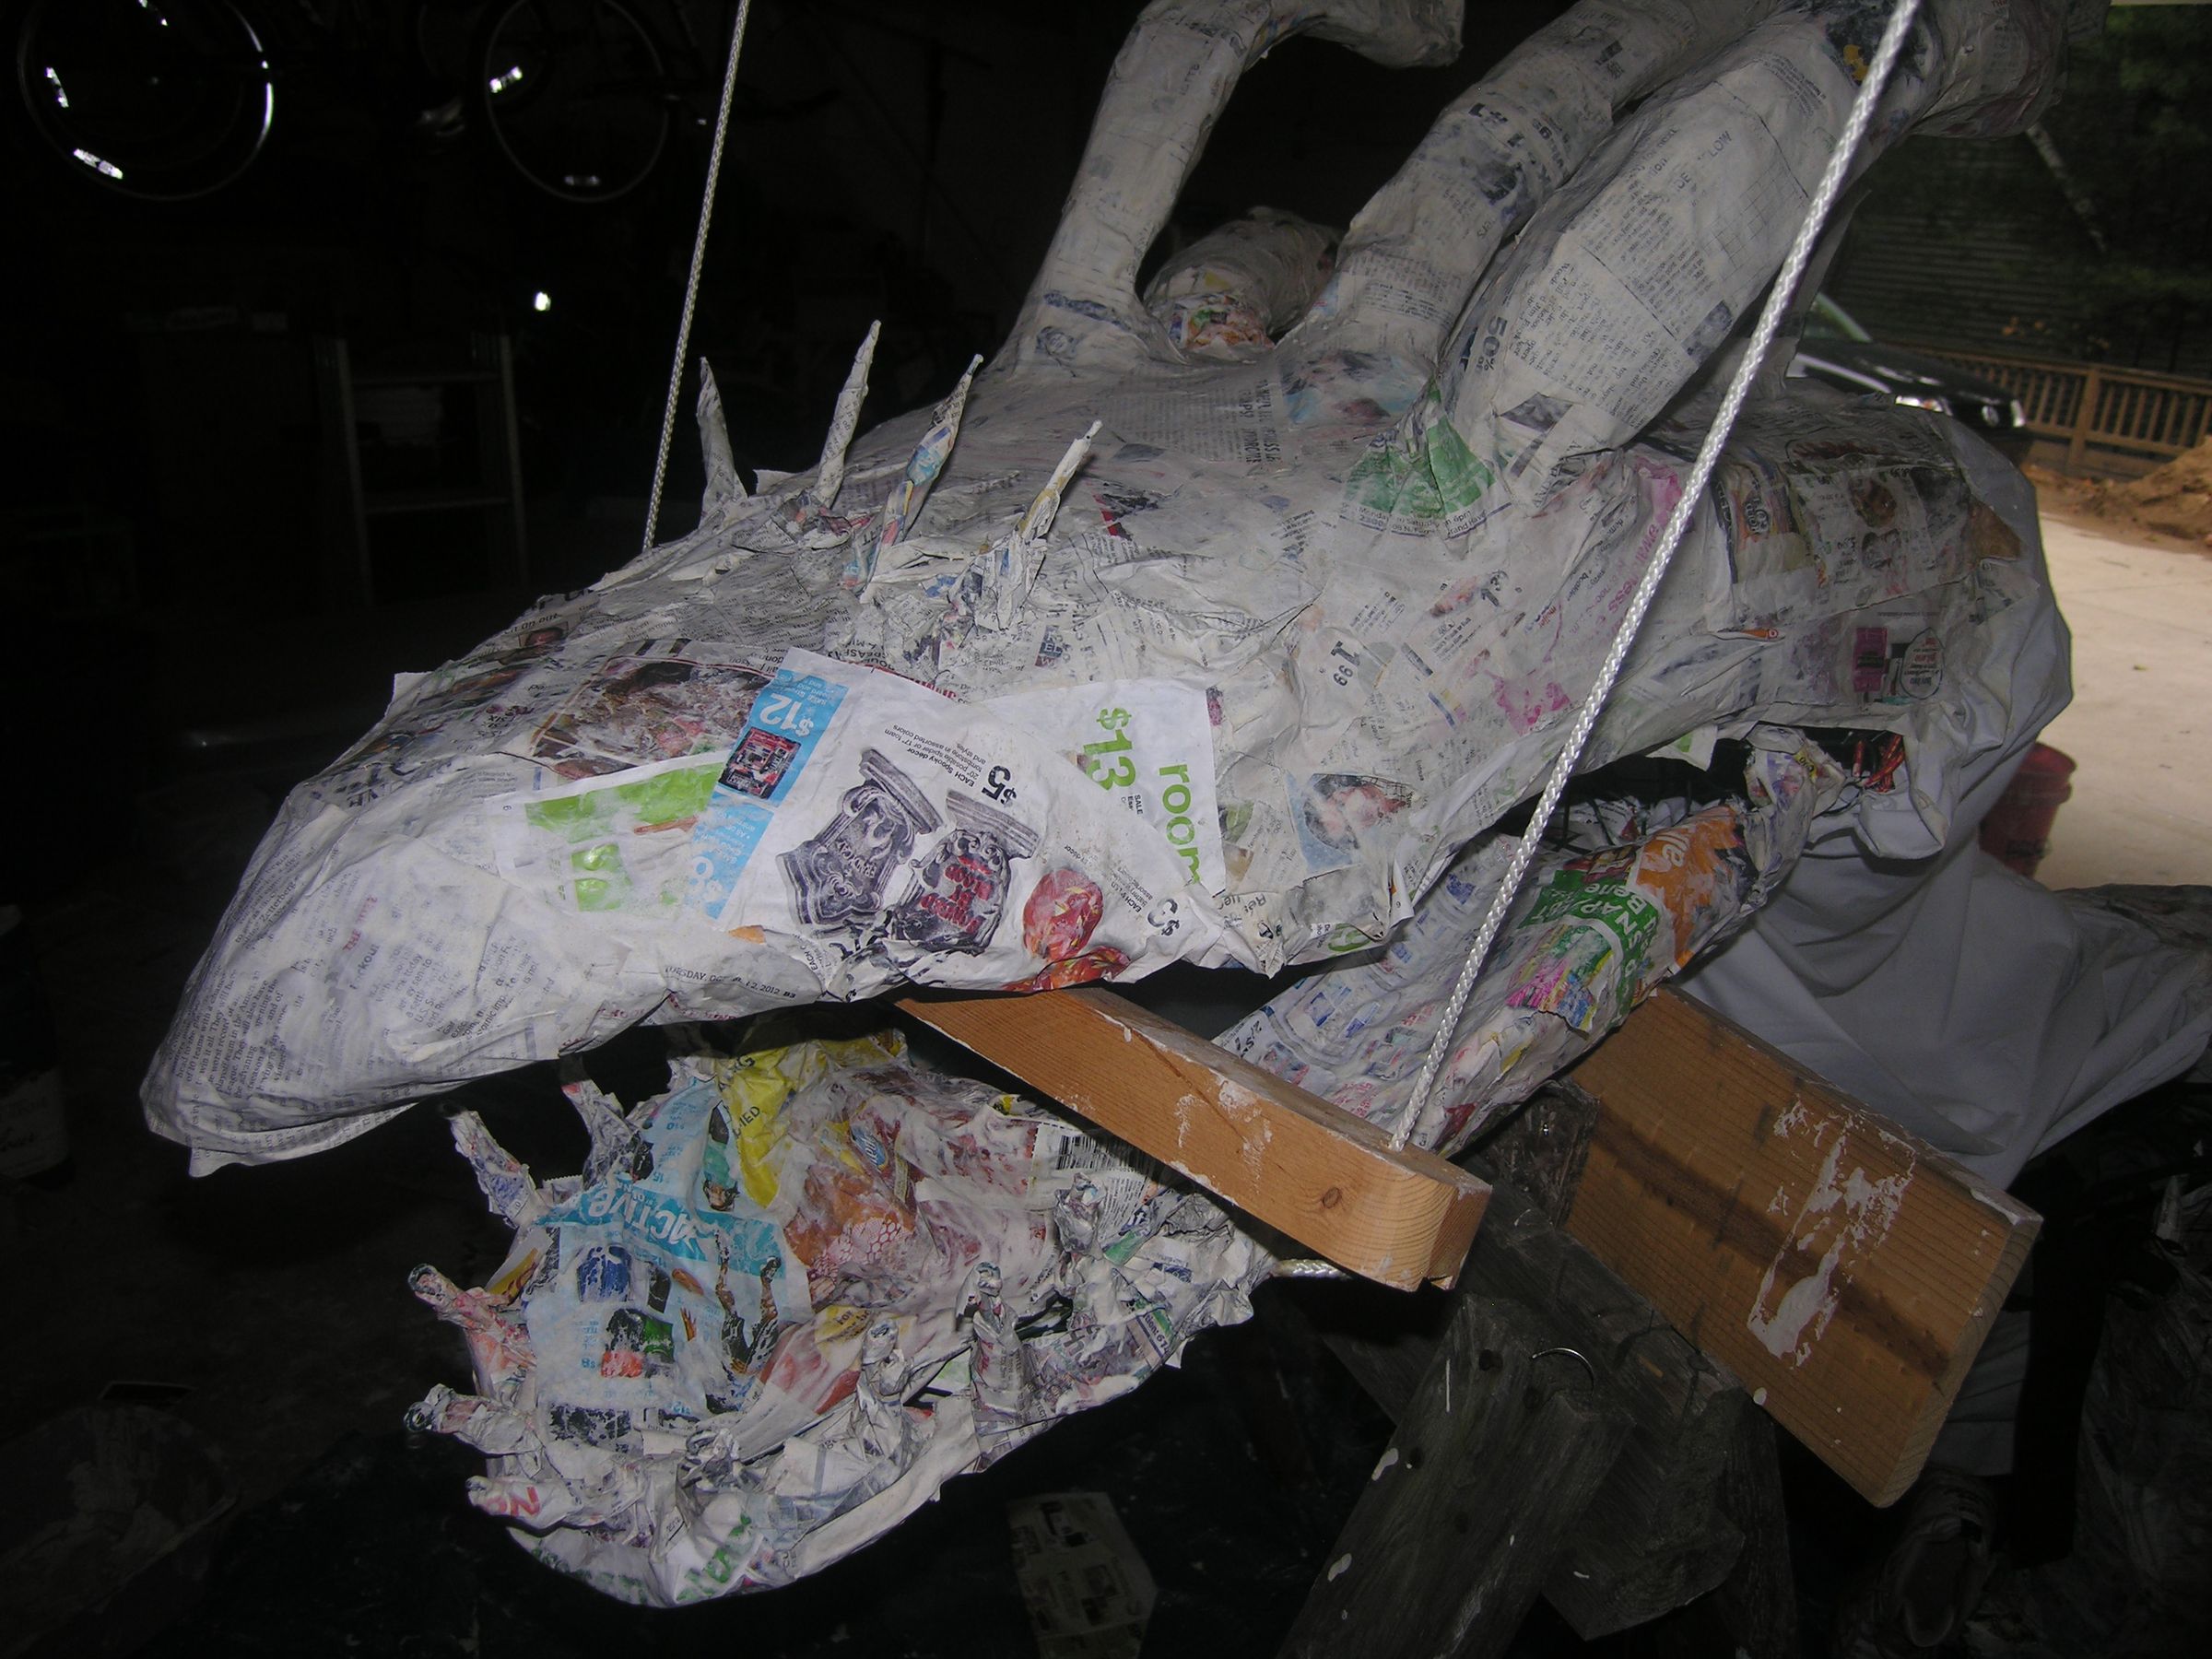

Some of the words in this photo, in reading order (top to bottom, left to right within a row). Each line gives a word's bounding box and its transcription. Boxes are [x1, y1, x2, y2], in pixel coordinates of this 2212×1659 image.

[757, 688, 820, 742] $12
[883, 727, 901, 742] foam
[891, 722, 914, 739] colors
[912, 730, 944, 753] assorted
[921, 742, 944, 760] spider
[1081, 706, 1135, 790] $13
[927, 754, 955, 774] Spooky
[949, 748, 983, 772] tombstone
[972, 754, 986, 765] and
[953, 770, 975, 787] EACH
[978, 761, 1026, 809] $5
[1123, 894, 1142, 912] EACH
[759, 983, 780, 994] 2012
[198, 1011, 212, 1032] with
[208, 1008, 225, 1033] They
[231, 1039, 247, 1062] They
[244, 1000, 258, 1019] also
[252, 977, 269, 1001] have
[265, 1002, 278, 1021] and
[191, 1033, 206, 1060] teams
[208, 1047, 225, 1072] worst
